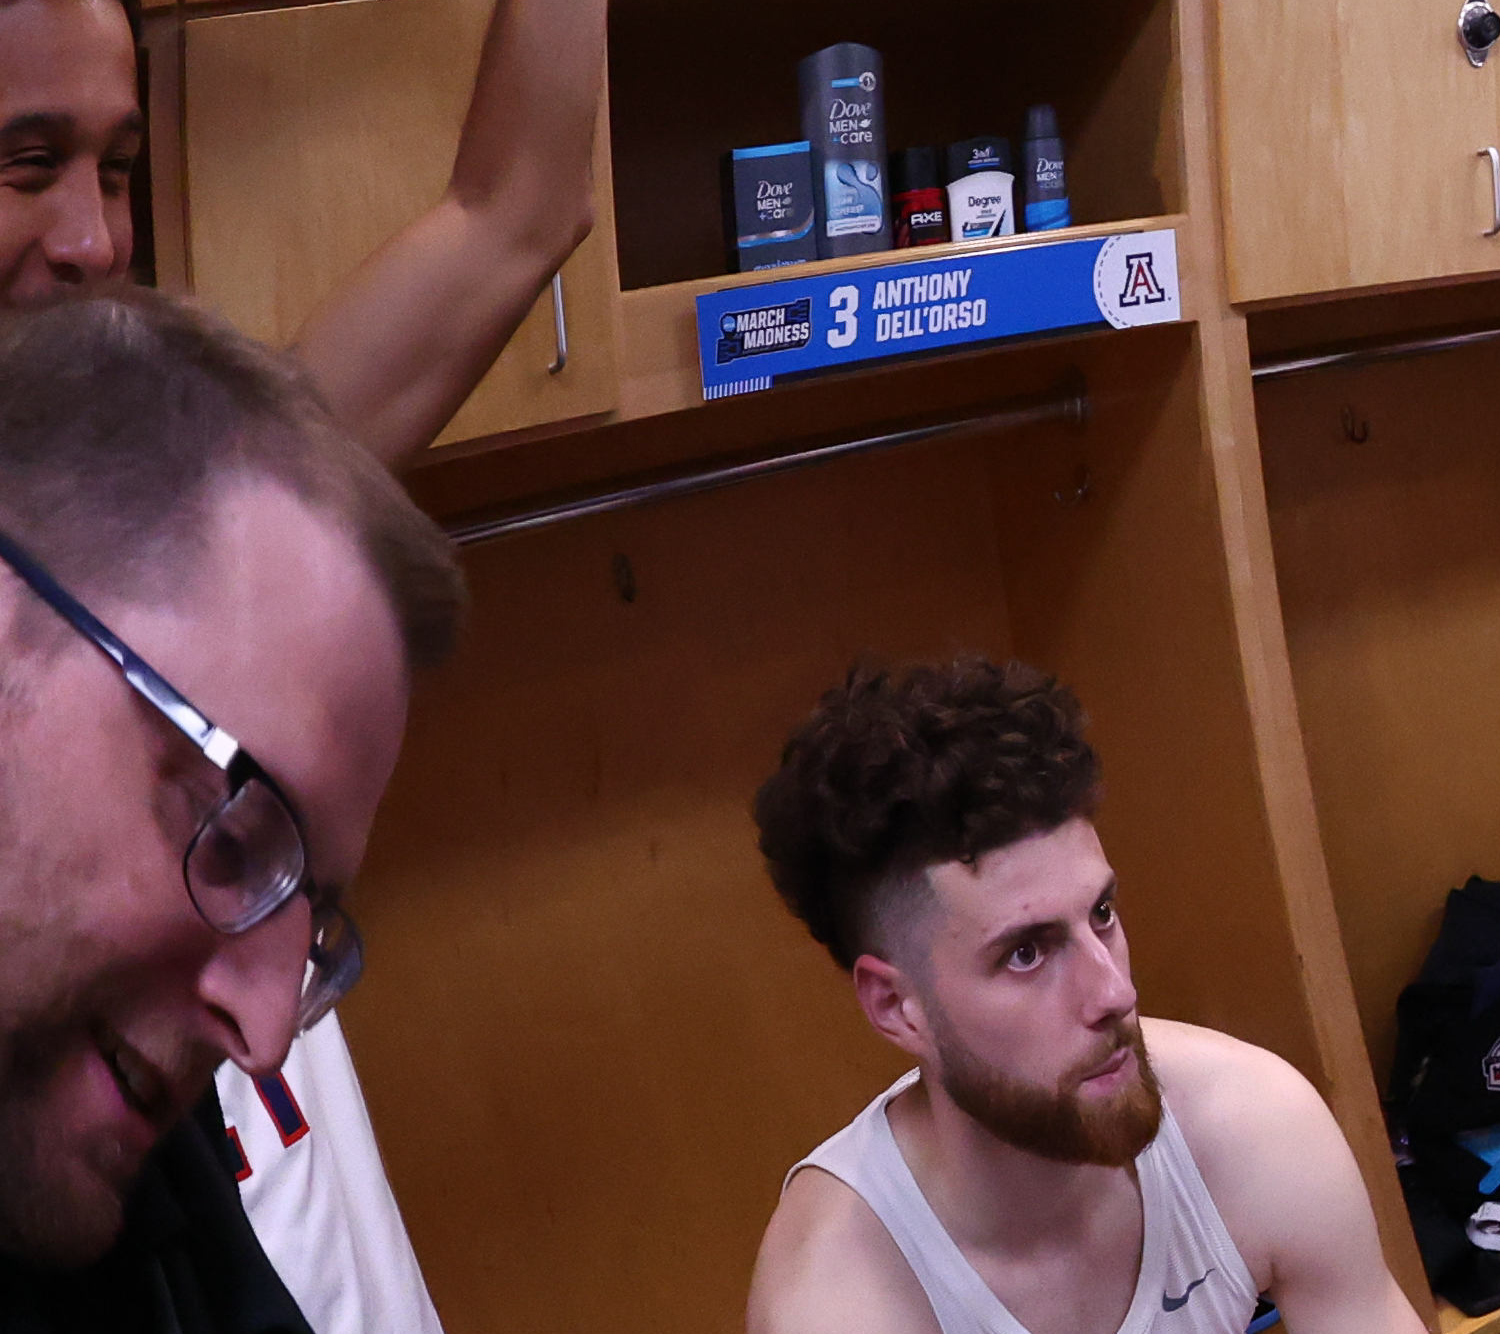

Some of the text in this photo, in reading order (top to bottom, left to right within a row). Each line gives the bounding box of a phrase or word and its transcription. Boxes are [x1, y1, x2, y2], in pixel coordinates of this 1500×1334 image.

[829, 98, 872, 119] Dove
[829, 120, 858, 135] MEN
[757, 180, 793, 199] Dove
[757, 198, 782, 211] MEN
[968, 195, 1002, 208] Degree
[911, 211, 943, 226] AXE
[872, 268, 972, 310] ANTHONY
[1118, 252, 1166, 308] A
[736, 307, 786, 333] MARCH
[826, 284, 860, 349] 3
[875, 298, 987, 343] DELL'ORSO
[743, 322, 810, 350] MADNESS
